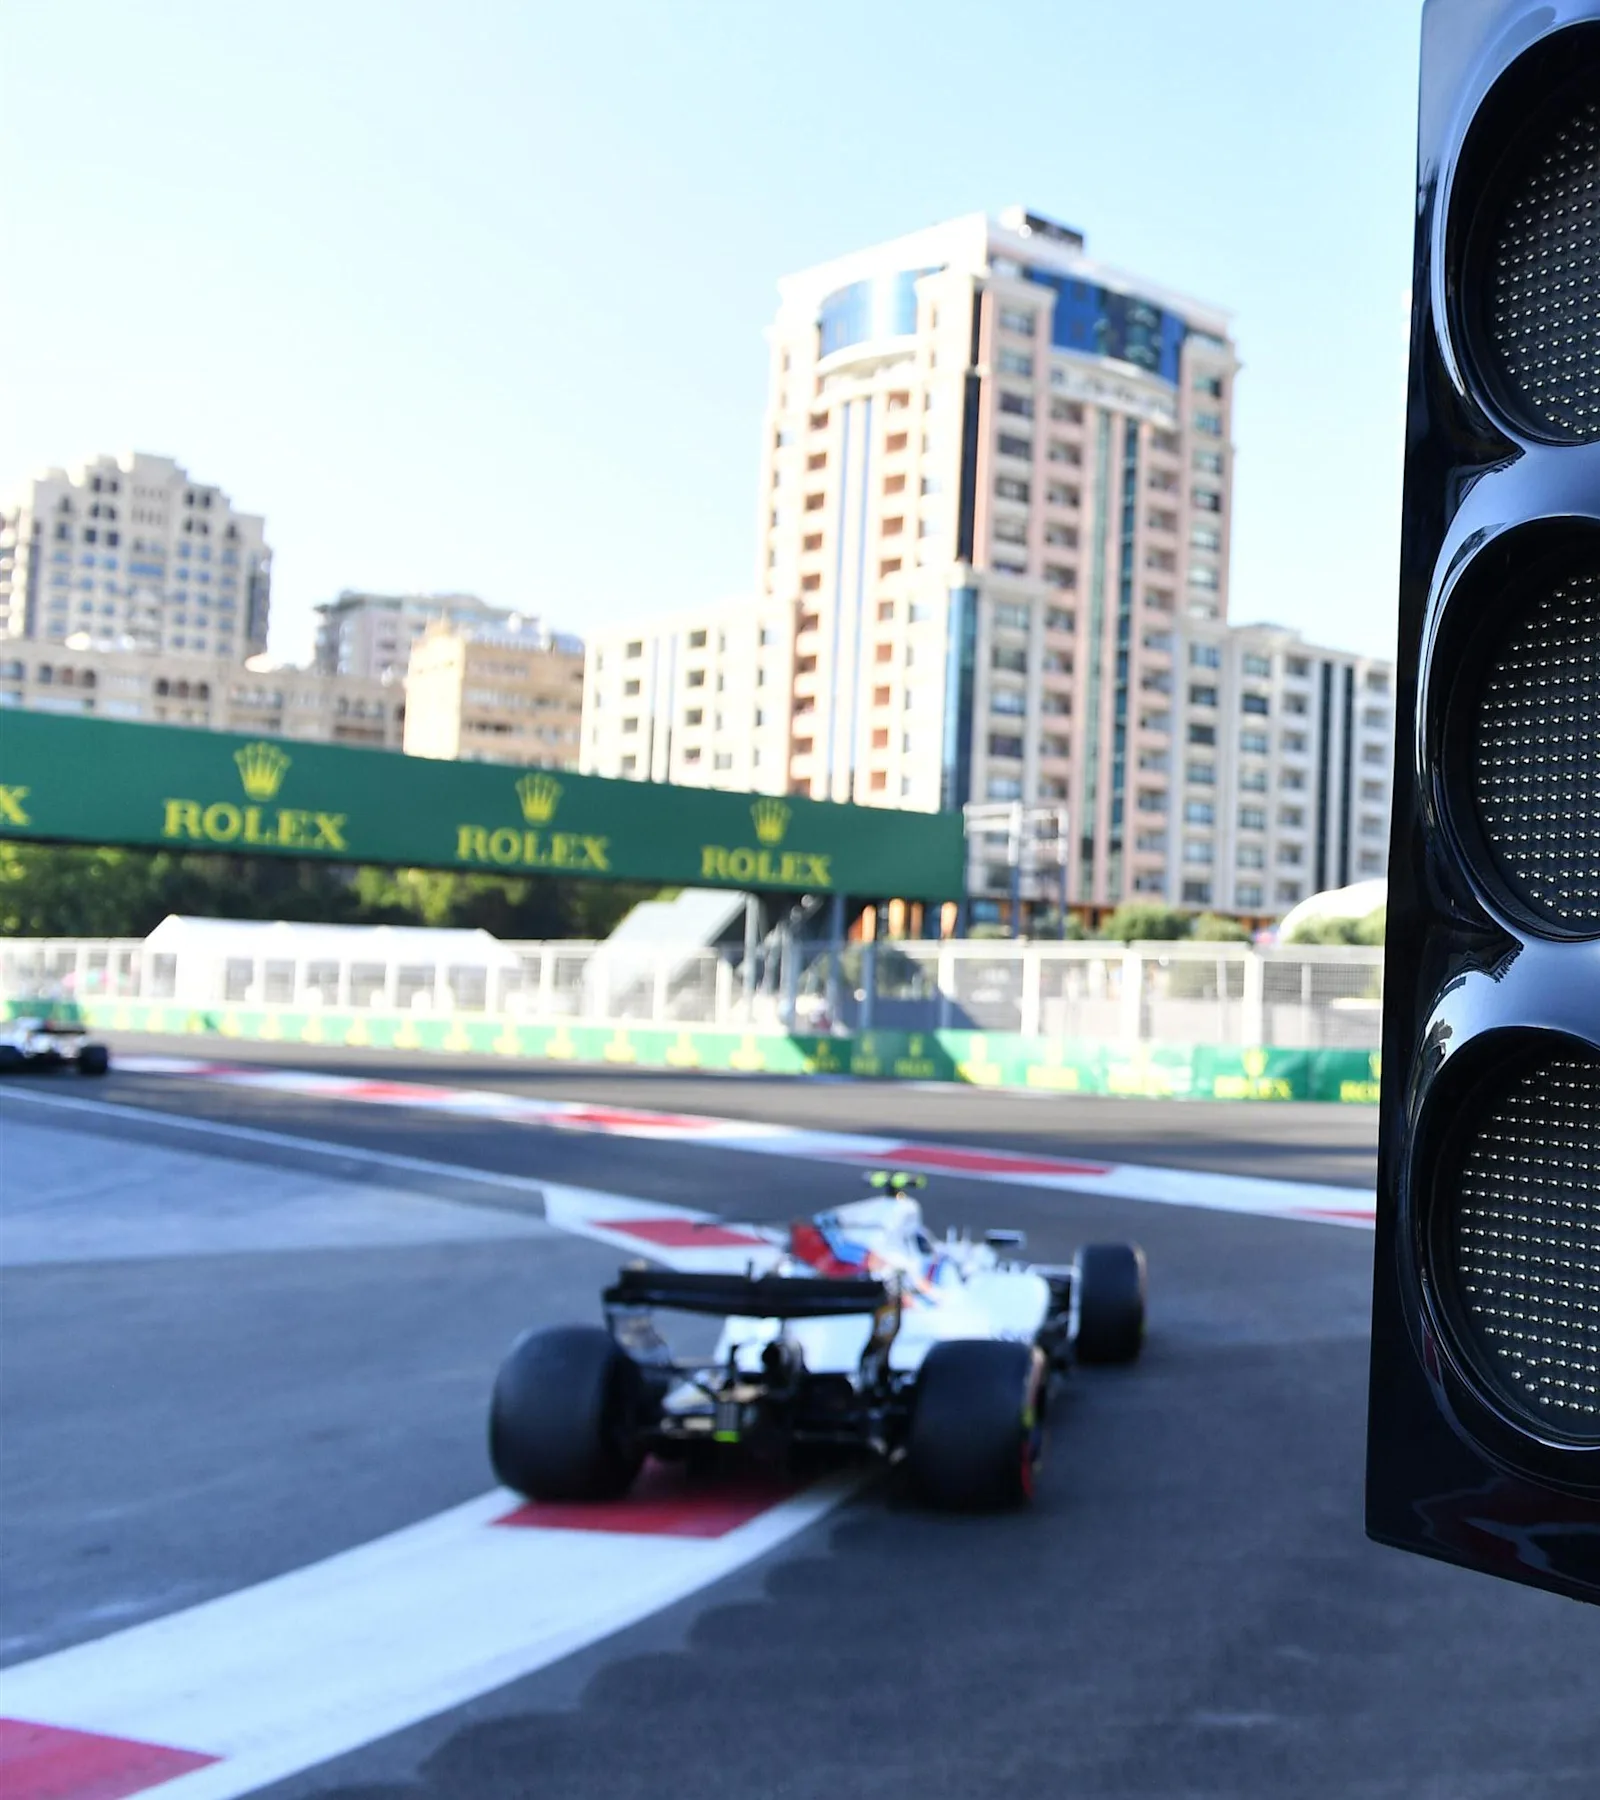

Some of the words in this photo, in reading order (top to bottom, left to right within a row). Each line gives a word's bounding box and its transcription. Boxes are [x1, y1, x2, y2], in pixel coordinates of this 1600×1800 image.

[163, 798, 347, 851] ROLEX
[457, 824, 610, 871] ROLEX
[701, 844, 830, 887] ROLEX
